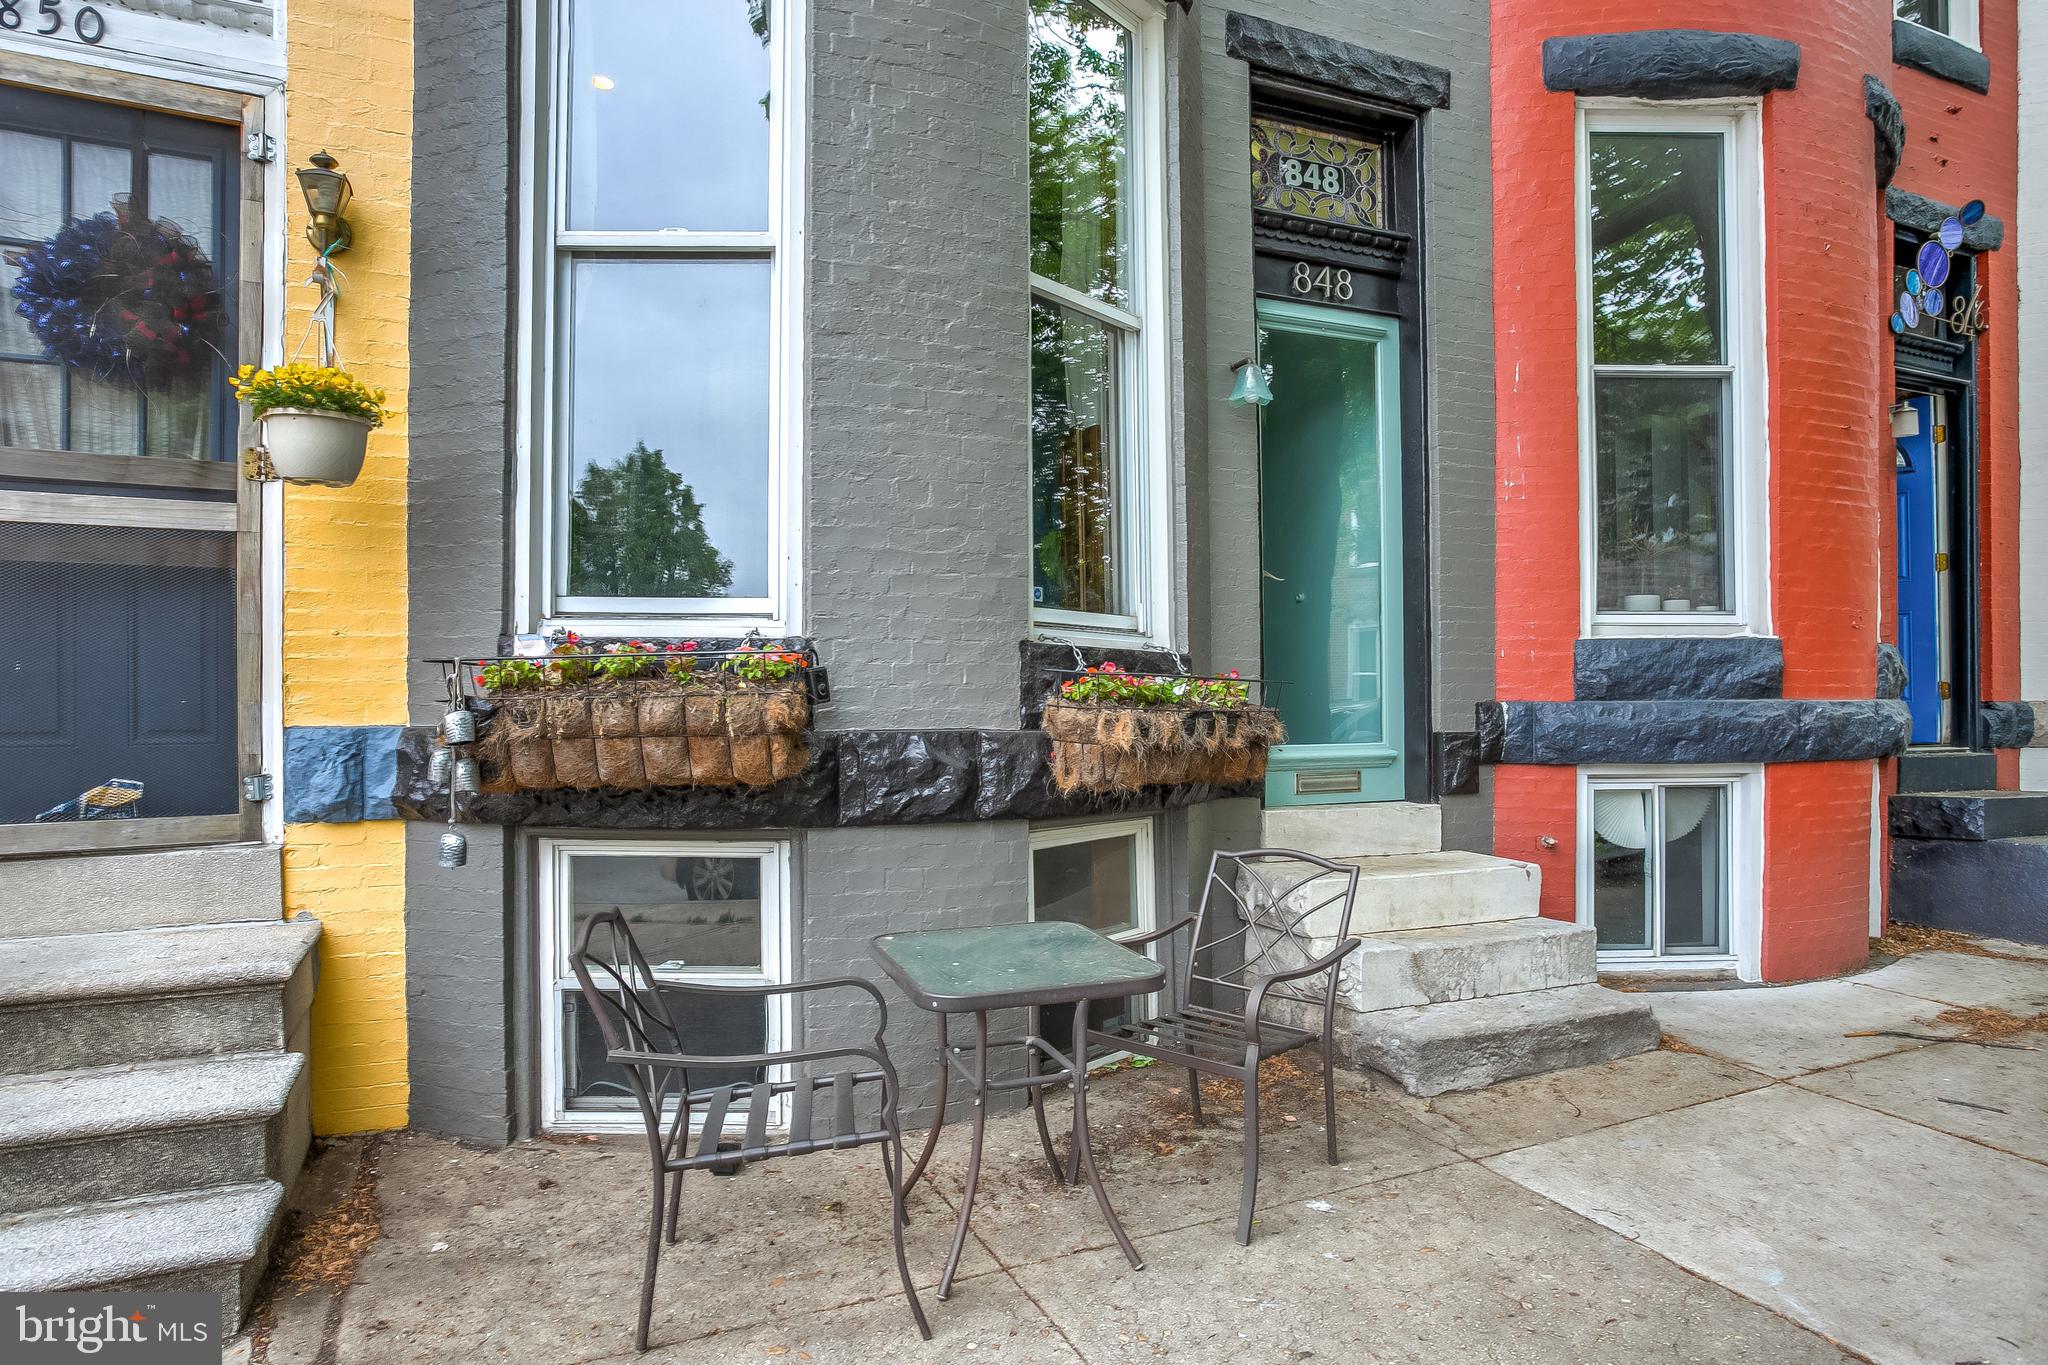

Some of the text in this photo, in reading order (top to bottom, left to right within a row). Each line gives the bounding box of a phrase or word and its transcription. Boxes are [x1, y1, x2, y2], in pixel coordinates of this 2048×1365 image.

[0, 0, 105, 44] 850
[1284, 159, 1340, 195] 848
[1294, 261, 1353, 300] 848
